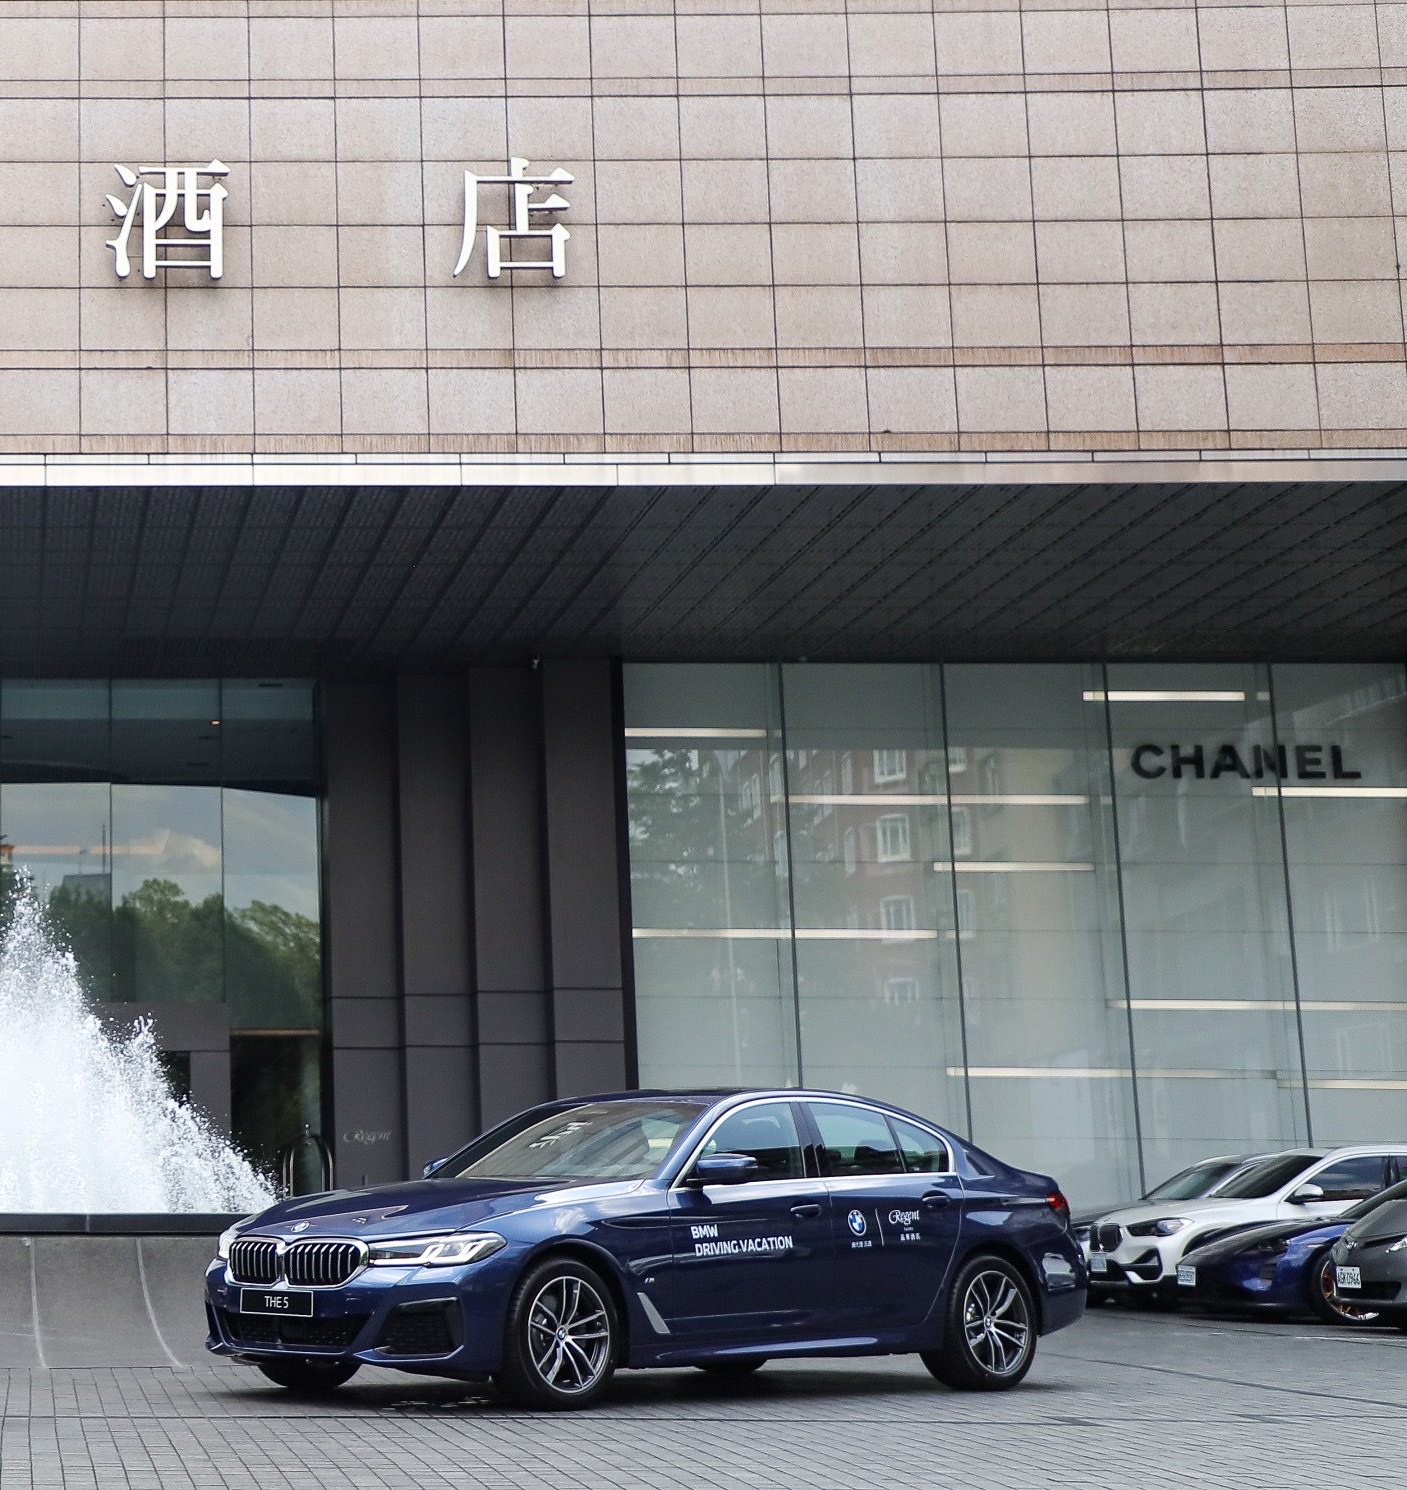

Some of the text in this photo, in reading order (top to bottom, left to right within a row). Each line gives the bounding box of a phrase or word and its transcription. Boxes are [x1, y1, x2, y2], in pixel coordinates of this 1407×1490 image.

[1130, 744, 1362, 780] CHANEL
[888, 1209, 920, 1226] Regent
[691, 1224, 719, 1239] BMW
[695, 1235, 793, 1257] DRIVING VACATION
[264, 1296, 289, 1309] THE 5
